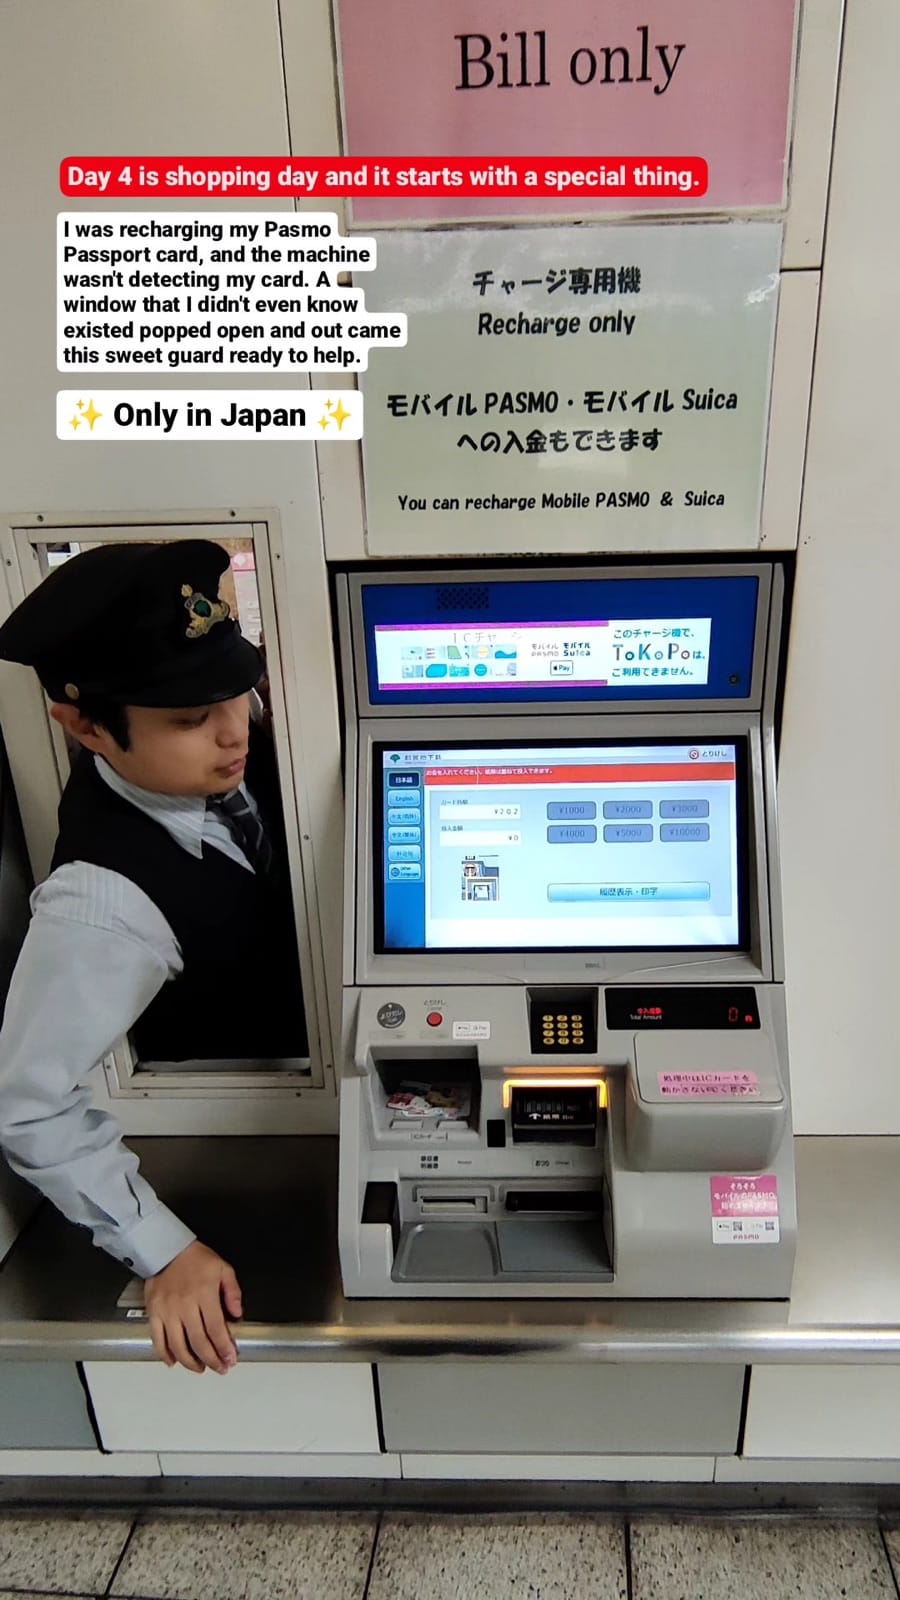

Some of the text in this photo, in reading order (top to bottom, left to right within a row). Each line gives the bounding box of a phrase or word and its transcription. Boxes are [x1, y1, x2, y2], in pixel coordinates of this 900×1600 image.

[453, 25, 686, 96] Bill only
[472, 266, 641, 296] チャージ専用機
[478, 309, 636, 337] Recharge only
[386, 392, 478, 418] モバイル
[682, 387, 738, 411] Suica
[456, 427, 663, 455] への入金もできます
[397, 490, 725, 512] You can recharge Mobile PASMO & Suica
